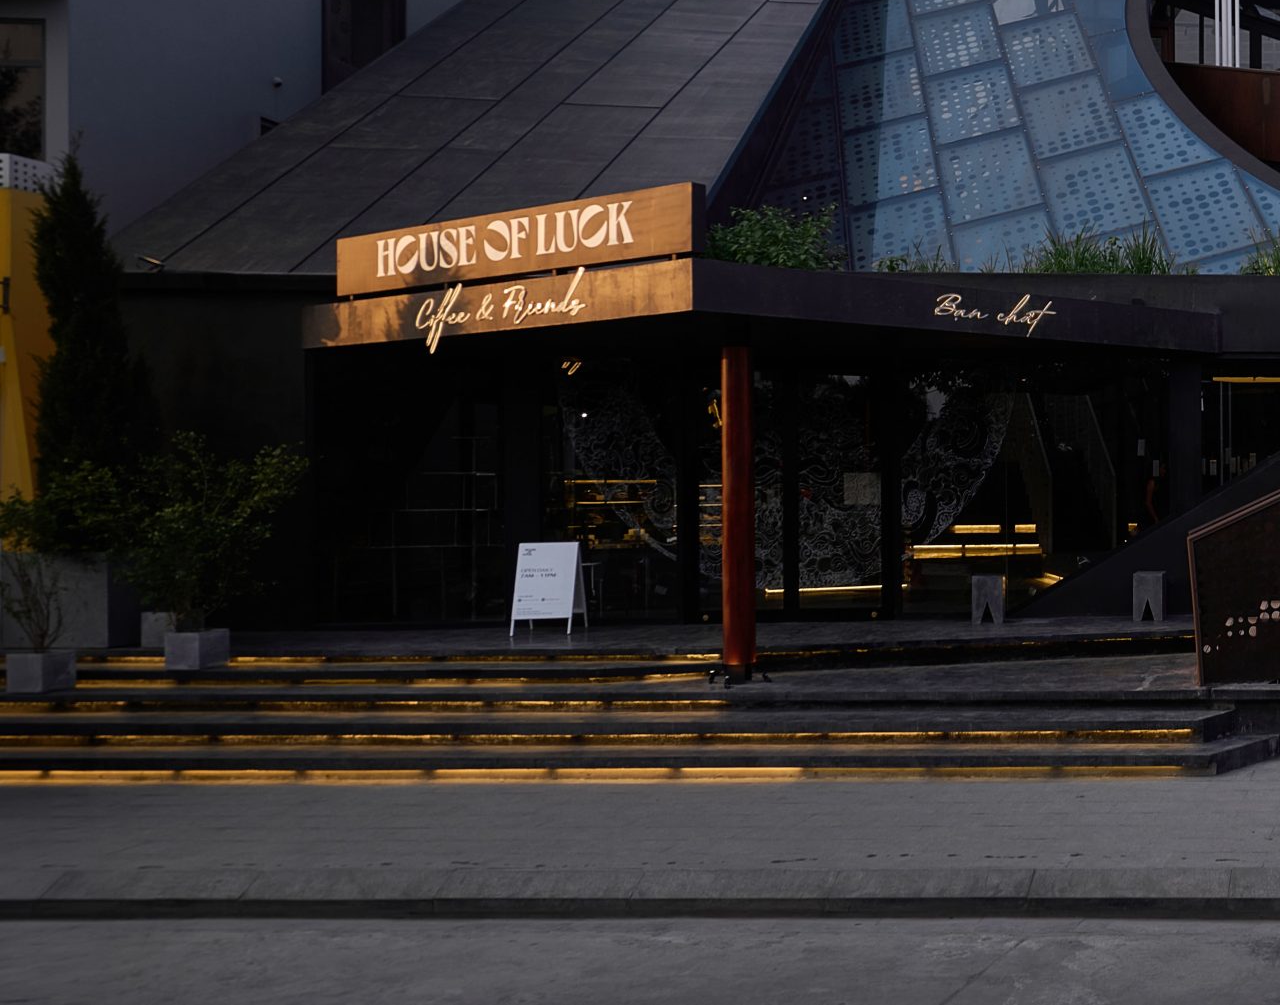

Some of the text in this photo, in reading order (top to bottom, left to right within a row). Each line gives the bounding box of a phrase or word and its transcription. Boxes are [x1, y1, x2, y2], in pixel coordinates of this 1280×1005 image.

[376, 200, 634, 278] HOUSE OF LUCK
[415, 266, 586, 355] Coffee & Friends
